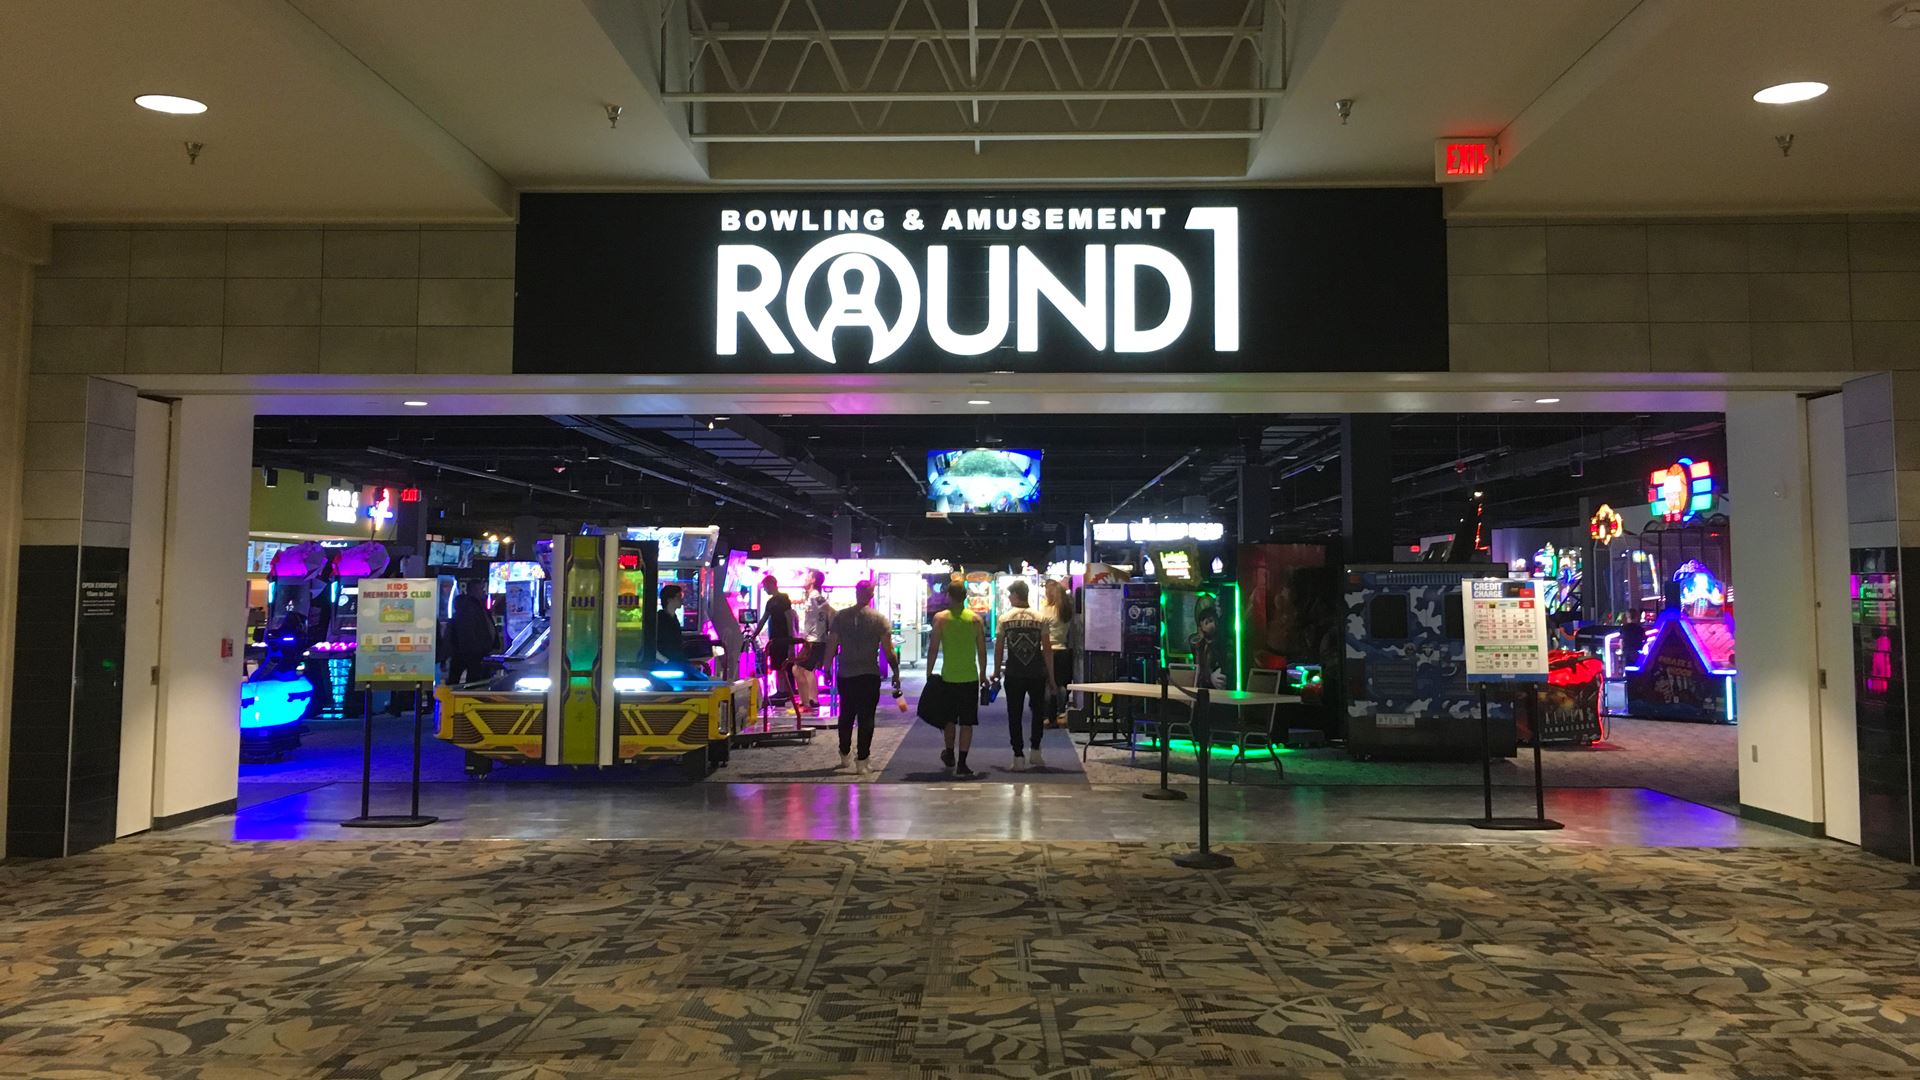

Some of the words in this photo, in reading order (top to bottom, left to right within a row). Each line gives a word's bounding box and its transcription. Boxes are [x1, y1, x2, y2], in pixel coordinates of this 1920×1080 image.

[1446, 143, 1486, 175] EXIT
[720, 208, 885, 232] BOWLING
[902, 208, 925, 231] &
[941, 207, 1167, 231] AMUSEMENT
[387, 583, 408, 591] KIDS
[1473, 582, 1502, 591] CREDIT
[363, 591, 408, 599] MEMBER'S
[410, 591, 432, 599] CLUB
[1474, 590, 1502, 598] CHARGE
